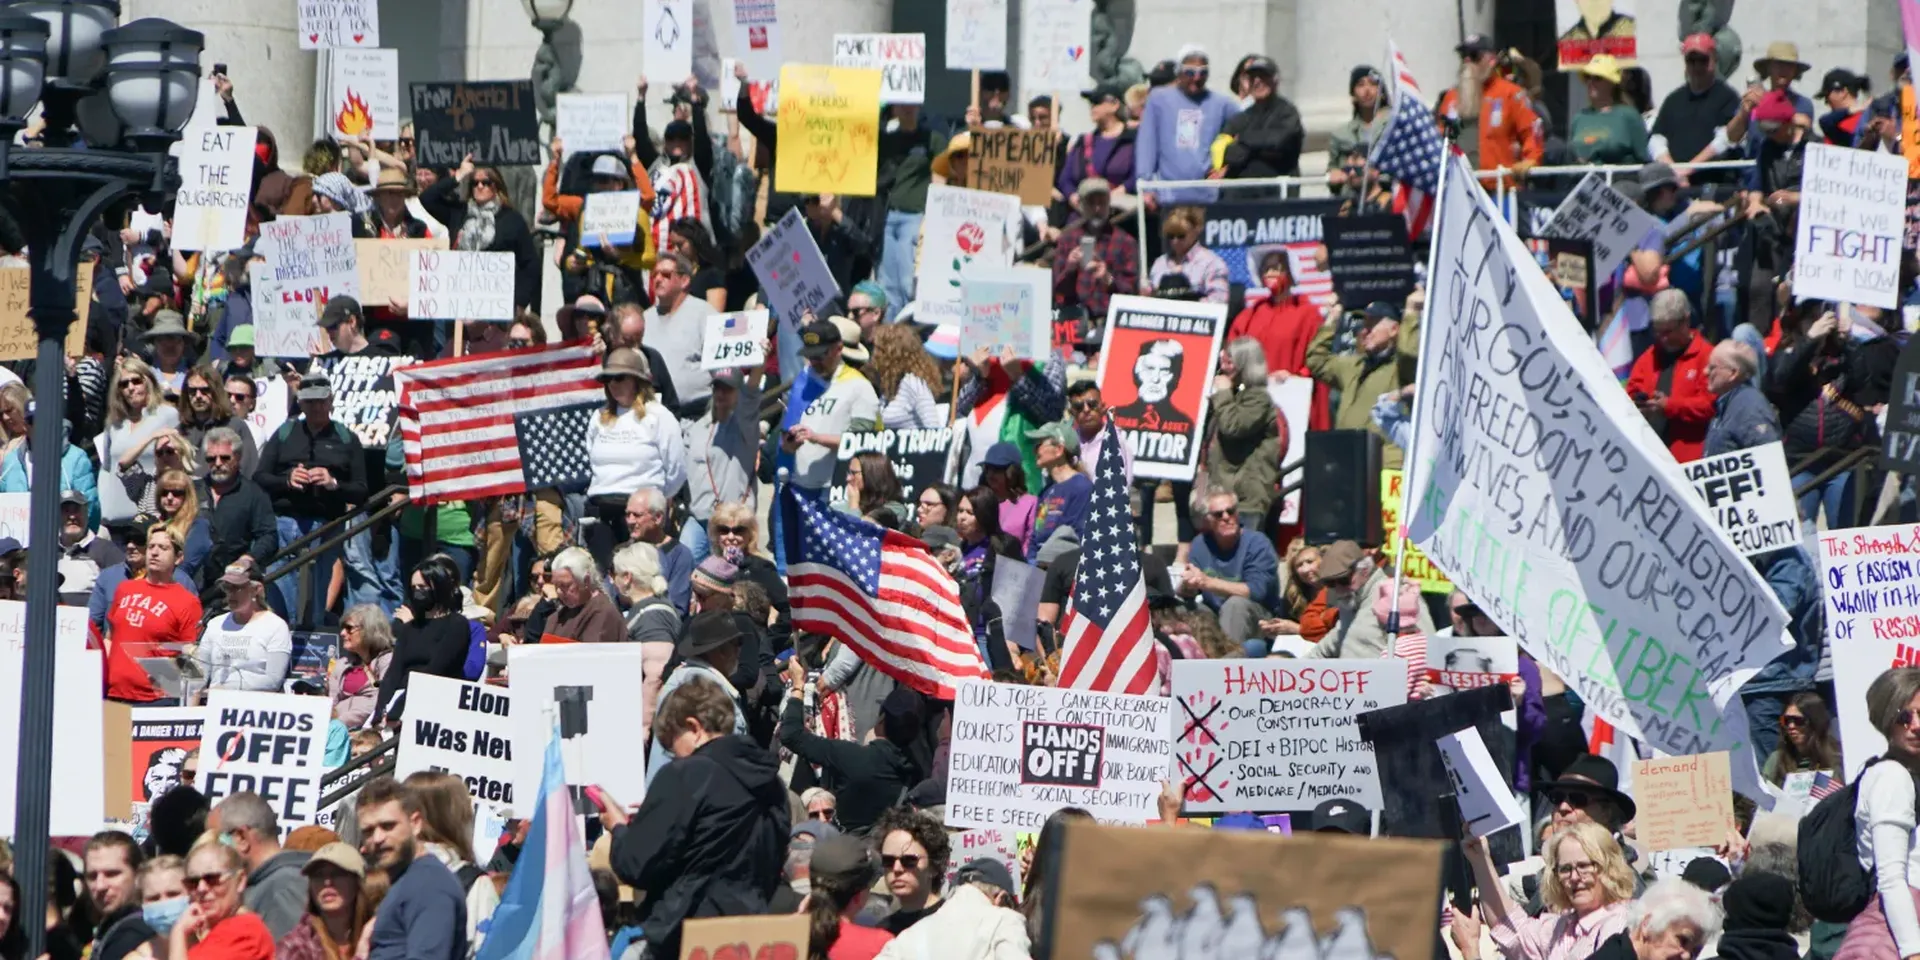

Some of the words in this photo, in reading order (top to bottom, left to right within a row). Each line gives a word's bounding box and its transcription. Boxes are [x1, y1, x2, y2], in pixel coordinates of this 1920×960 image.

[836, 39, 874, 55] MAKE
[878, 36, 924, 60] NAZIS
[882, 64, 923, 92] AGAIN
[805, 116, 845, 132] HANDS
[201, 131, 234, 152] EAT
[419, 128, 482, 165] America
[488, 123, 540, 164] Alone
[969, 130, 1055, 165] IMPEACH
[199, 164, 230, 186] THE
[1813, 147, 1843, 170] The
[1849, 155, 1904, 185] future
[178, 189, 247, 209] OLIGARCHS
[1600, 187, 1632, 214] ONLY
[1805, 175, 1900, 206] demands
[1572, 207, 1589, 224] BE
[1590, 223, 1603, 236] A
[1575, 190, 1610, 219] WANT
[1610, 215, 1629, 236] TO
[1807, 198, 1847, 225] that
[1860, 212, 1890, 230] we
[267, 220, 301, 240] POWER
[313, 215, 330, 232] TO
[279, 237, 297, 252] THE
[306, 229, 344, 249] PEOPLE
[324, 244, 351, 260] MUSK
[1809, 225, 1896, 264] FIGHT
[275, 261, 319, 281] IMPEACH
[418, 250, 440, 272] NO
[458, 251, 511, 273] KINGS
[418, 274, 440, 293] NO
[447, 273, 513, 294] DICTATORS
[1799, 256, 1821, 279] for
[1833, 264, 1846, 281] it
[1854, 267, 1898, 293] NOW
[417, 298, 439, 319] NO
[448, 298, 510, 319] NAZIS
[787, 284, 826, 328] ACTION
[1450, 269, 1492, 360] OUR
[1119, 312, 1129, 327] A
[1129, 313, 1165, 330] DANGER
[1167, 317, 1180, 332] TO
[1180, 319, 1193, 333] US
[1193, 320, 1211, 335] ALL
[330, 373, 379, 392] UITY
[333, 390, 397, 408] LUSION
[837, 428, 896, 461] DUMP
[897, 428, 953, 455] TRUMP
[1124, 430, 1189, 460] AITOR
[1694, 468, 1765, 508] FF!
[1527, 492, 1596, 563] AND
[1746, 508, 1759, 524] &
[1728, 518, 1796, 553] ECURITY
[1820, 536, 1849, 558] The
[1853, 531, 1909, 557] Strength
[1458, 507, 1533, 619] TITLE
[1548, 587, 1606, 657] OF
[1828, 564, 1849, 590] OF
[1856, 557, 1912, 587] FASCISM
[120, 593, 168, 618] UTAH
[1431, 534, 1476, 596] ALMA
[1481, 585, 1531, 645] 46:12
[1543, 640, 1572, 678] NO
[1882, 585, 1901, 608] in
[1835, 618, 1856, 640] OF
[1870, 614, 1920, 641] Resist
[1223, 665, 1315, 695] HANDS
[1319, 667, 1373, 695] OFF
[1439, 670, 1503, 688] RESIST
[458, 684, 510, 717] Elon
[961, 682, 1000, 707] OUR
[1003, 687, 1048, 708] JOBS
[1061, 691, 1112, 712] CANCER
[1113, 696, 1169, 714] RESEARCH
[1228, 706, 1257, 721] OUR
[1259, 697, 1355, 715] DEMOCRACY
[1363, 700, 1379, 710] AND
[132, 727, 140, 738] A
[139, 723, 172, 738] DANGER
[174, 724, 185, 737] TO
[185, 724, 197, 737] US
[219, 707, 314, 733] HANDS
[956, 719, 1015, 744] COURTS
[1016, 706, 1048, 722] THE
[1055, 706, 1157, 733] CONSTITUTION
[415, 719, 467, 753] Was
[1025, 724, 1102, 755] HANDS
[1105, 732, 1170, 755] IMMIGRANTS
[1228, 740, 1262, 761] DEI
[1280, 737, 1329, 757] BIPOC
[1335, 736, 1375, 753] HISTOR
[216, 731, 312, 770] OFF!
[952, 752, 1022, 774] EDUCATION
[1101, 760, 1124, 782] OUR
[1237, 763, 1282, 781] SOCIAL
[1288, 762, 1347, 777] SECURITY
[1352, 765, 1372, 776] AND
[1640, 753, 1699, 777] demand
[950, 777, 978, 796] FREE
[978, 780, 1024, 799] ELECTIONS
[1031, 785, 1078, 805] SOCIAL
[1082, 788, 1151, 810] SECURITY
[952, 804, 995, 823] FREE
[963, 829, 1003, 849] HOME
